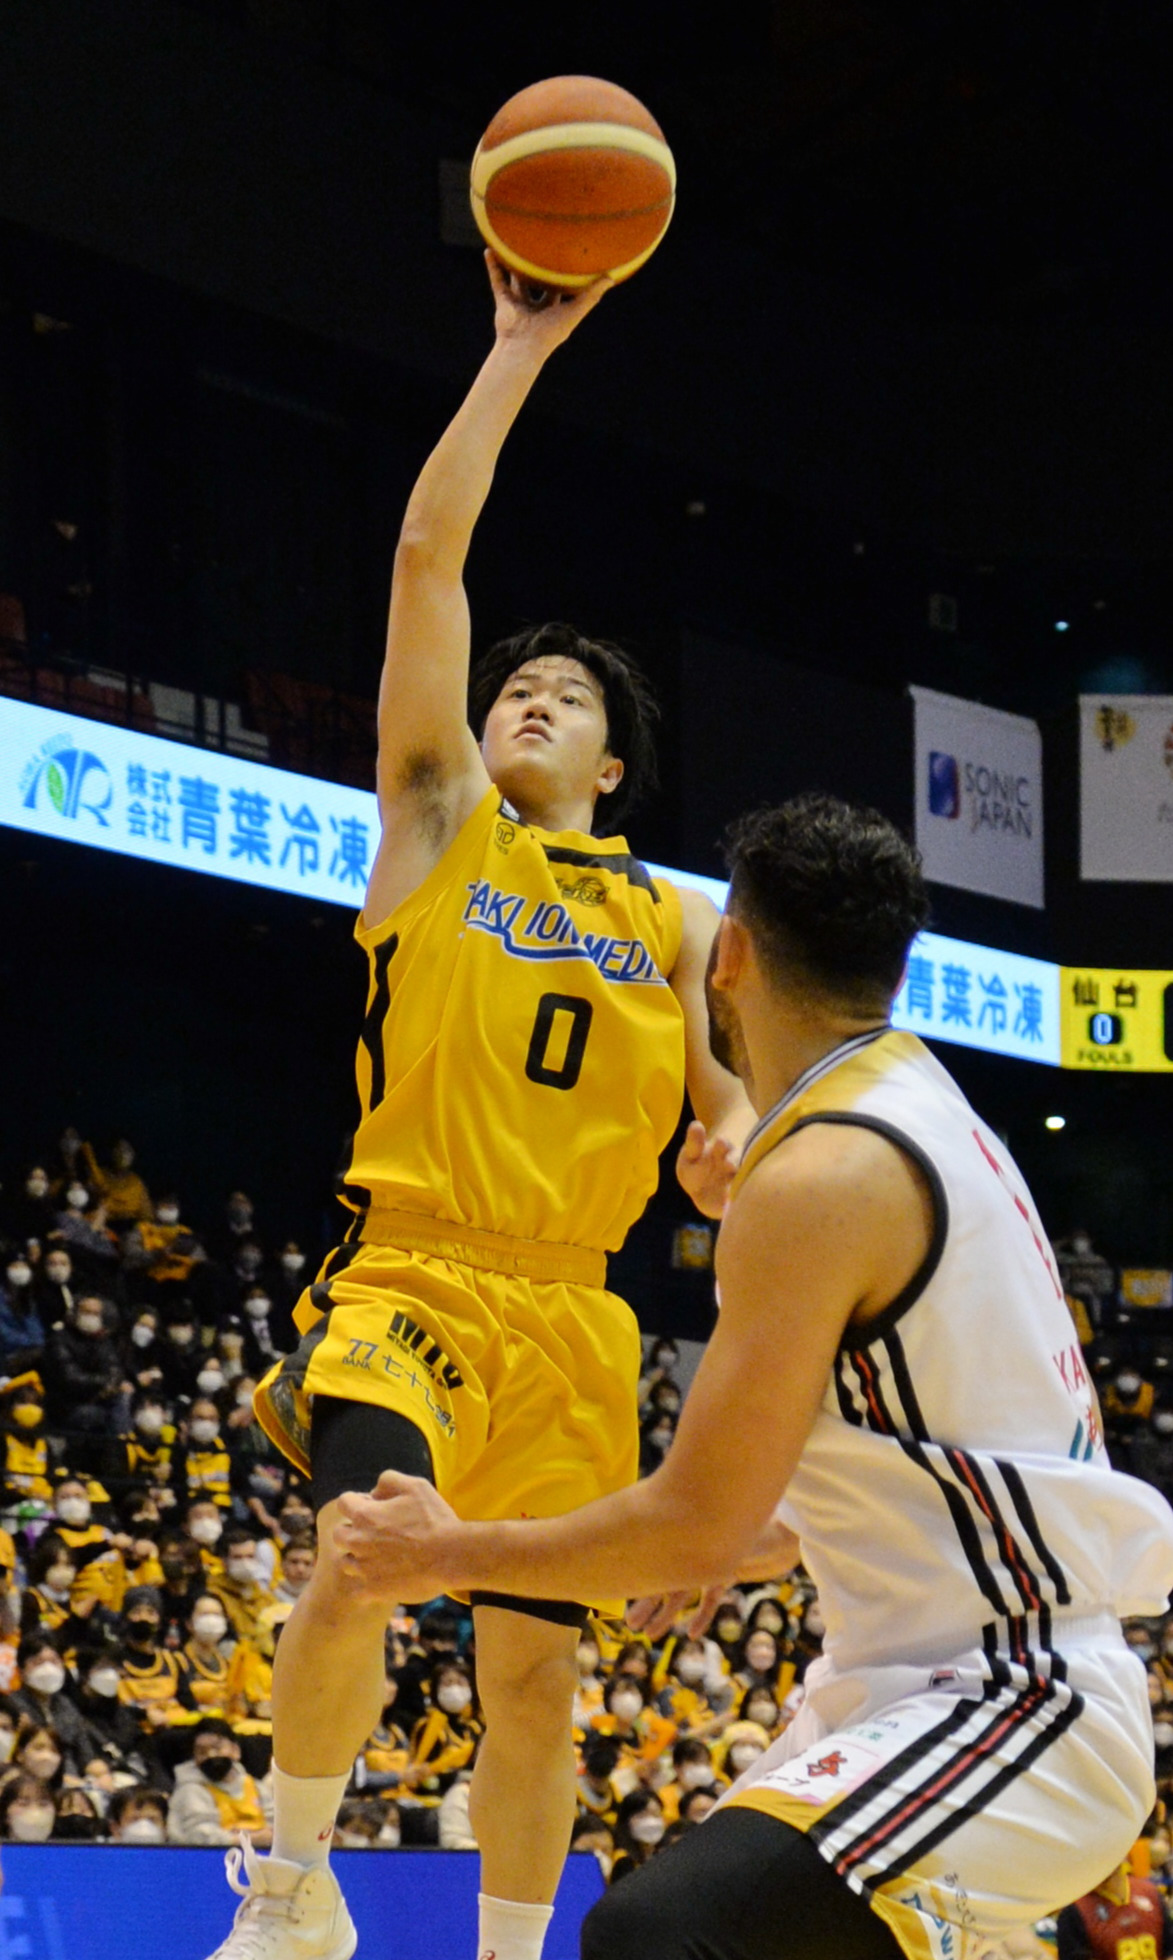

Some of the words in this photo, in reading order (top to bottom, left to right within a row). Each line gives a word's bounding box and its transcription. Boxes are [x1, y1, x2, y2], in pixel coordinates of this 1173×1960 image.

[965, 762, 1030, 807] SONIC
[126, 801, 172, 844] 会社
[178, 774, 369, 889] 青葉冷凍
[970, 798, 1033, 839] JAPAN
[583, 934, 664, 979] MEDI
[907, 956, 1044, 1043] 青葉冷凍
[1073, 977, 1137, 1008] 仙台
[525, 992, 593, 1091] 0
[1092, 1012, 1113, 1046] 0
[1077, 1048, 1134, 1065] FOULS
[342, 1356, 371, 1371] BANK
[349, 1338, 379, 1360] 77
